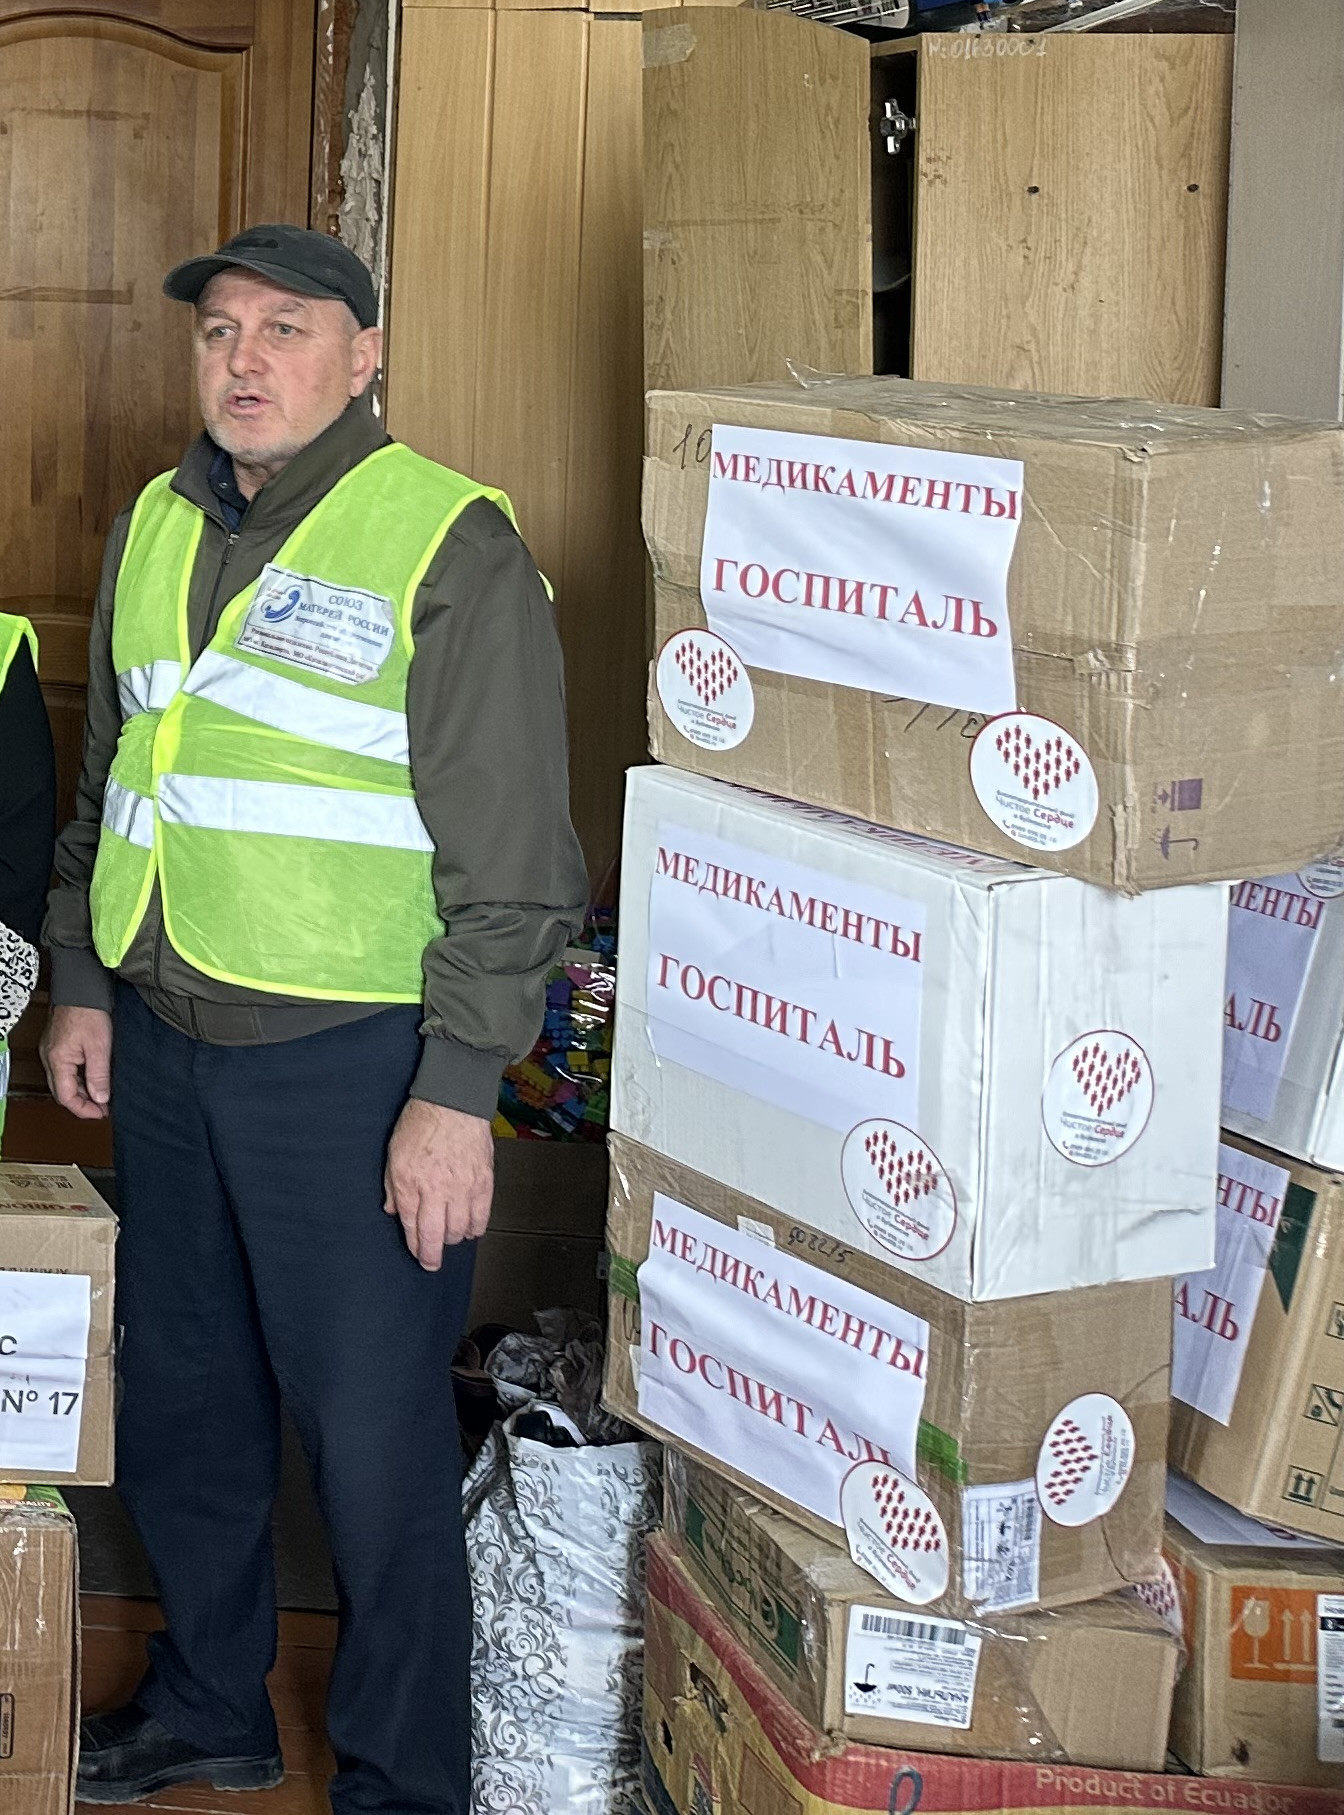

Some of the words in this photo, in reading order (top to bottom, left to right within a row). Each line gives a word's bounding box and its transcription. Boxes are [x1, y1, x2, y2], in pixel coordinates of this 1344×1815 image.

[713, 451, 1018, 520] МЕДИКАМЕНТЫ
[298, 602, 342, 621] МАТЕРЕЙ
[348, 615, 390, 637] РОССИИ
[329, 595, 363, 611] СОЮЗ
[713, 558, 998, 638] ГОСПИТАЛЬ
[1033, 808, 1074, 829] Сердце
[655, 847, 922, 963] МЕДИКАМЕНТЫ
[657, 952, 906, 1079] ГОСПИТАЛЬ
[652, 1219, 927, 1380] МЕДИКАМЕНТЫ
[49, 1391, 79, 1415] 17
[649, 1320, 892, 1466] ГОСПИТАЛ
[1035, 1768, 1143, 1799] Product
[1151, 1780, 1175, 1800] of
[1183, 1782, 1293, 1814] Ecuador
